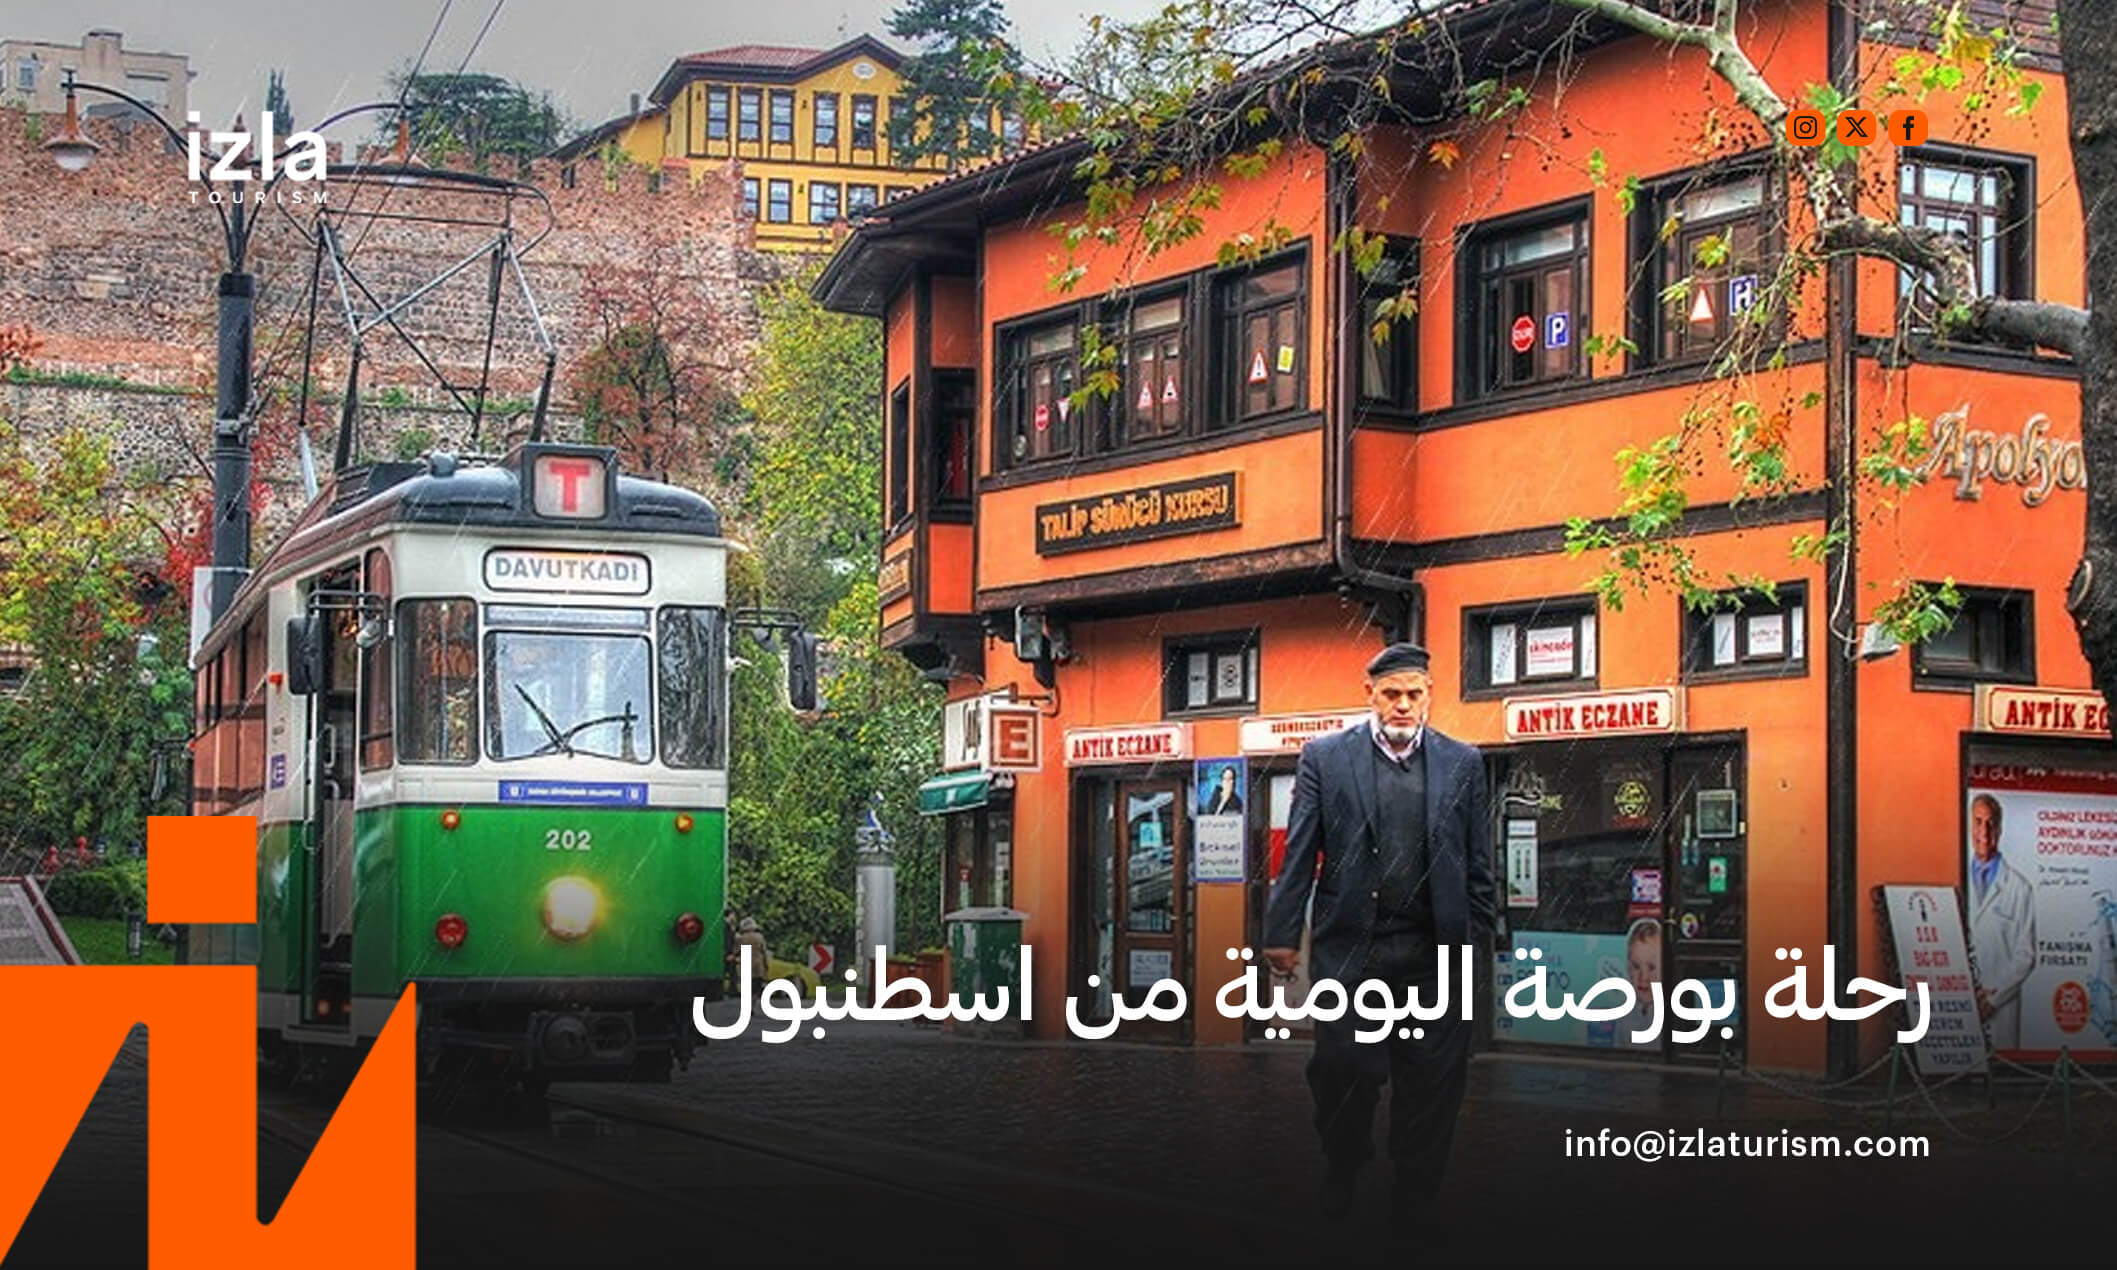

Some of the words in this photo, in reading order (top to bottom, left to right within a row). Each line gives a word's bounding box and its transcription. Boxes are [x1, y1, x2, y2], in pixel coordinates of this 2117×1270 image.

[1914, 403, 2088, 507] Apolyo
[548, 461, 591, 513] T
[494, 557, 639, 582] DAVUTKADI
[1516, 702, 1576, 734] ANTİK
[1580, 700, 1659, 729] ECZANE
[2004, 697, 2077, 729] ANTİK
[1000, 719, 1029, 759] E
[1072, 736, 1114, 760] ANTİK
[1116, 732, 1172, 757] ECZANE
[545, 829, 592, 851] 202
